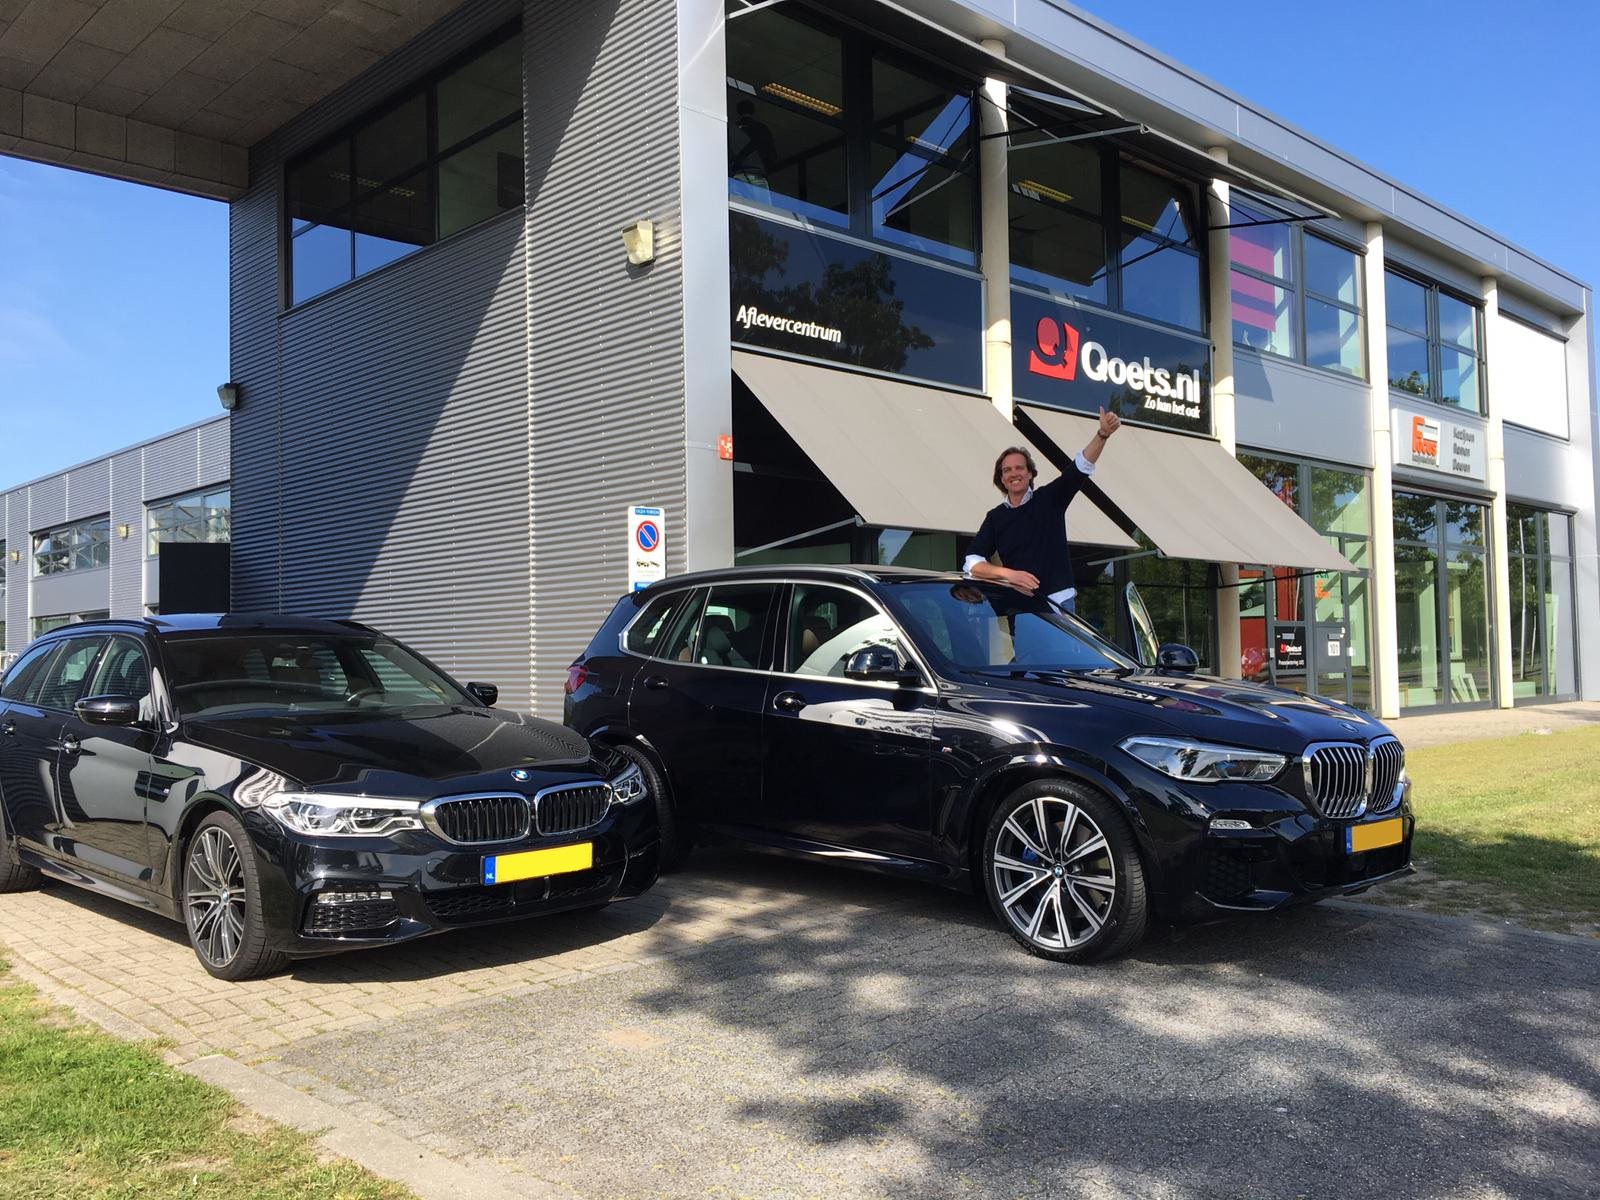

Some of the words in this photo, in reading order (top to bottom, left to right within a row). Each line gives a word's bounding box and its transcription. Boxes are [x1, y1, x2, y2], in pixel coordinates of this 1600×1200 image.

[736, 304, 842, 343] Aflevercentrum
[1081, 341, 1200, 403] Qoets.nl
[1144, 395, 1157, 410] Zo
[1172, 401, 1185, 416] het
[1185, 405, 1200, 419] ook
